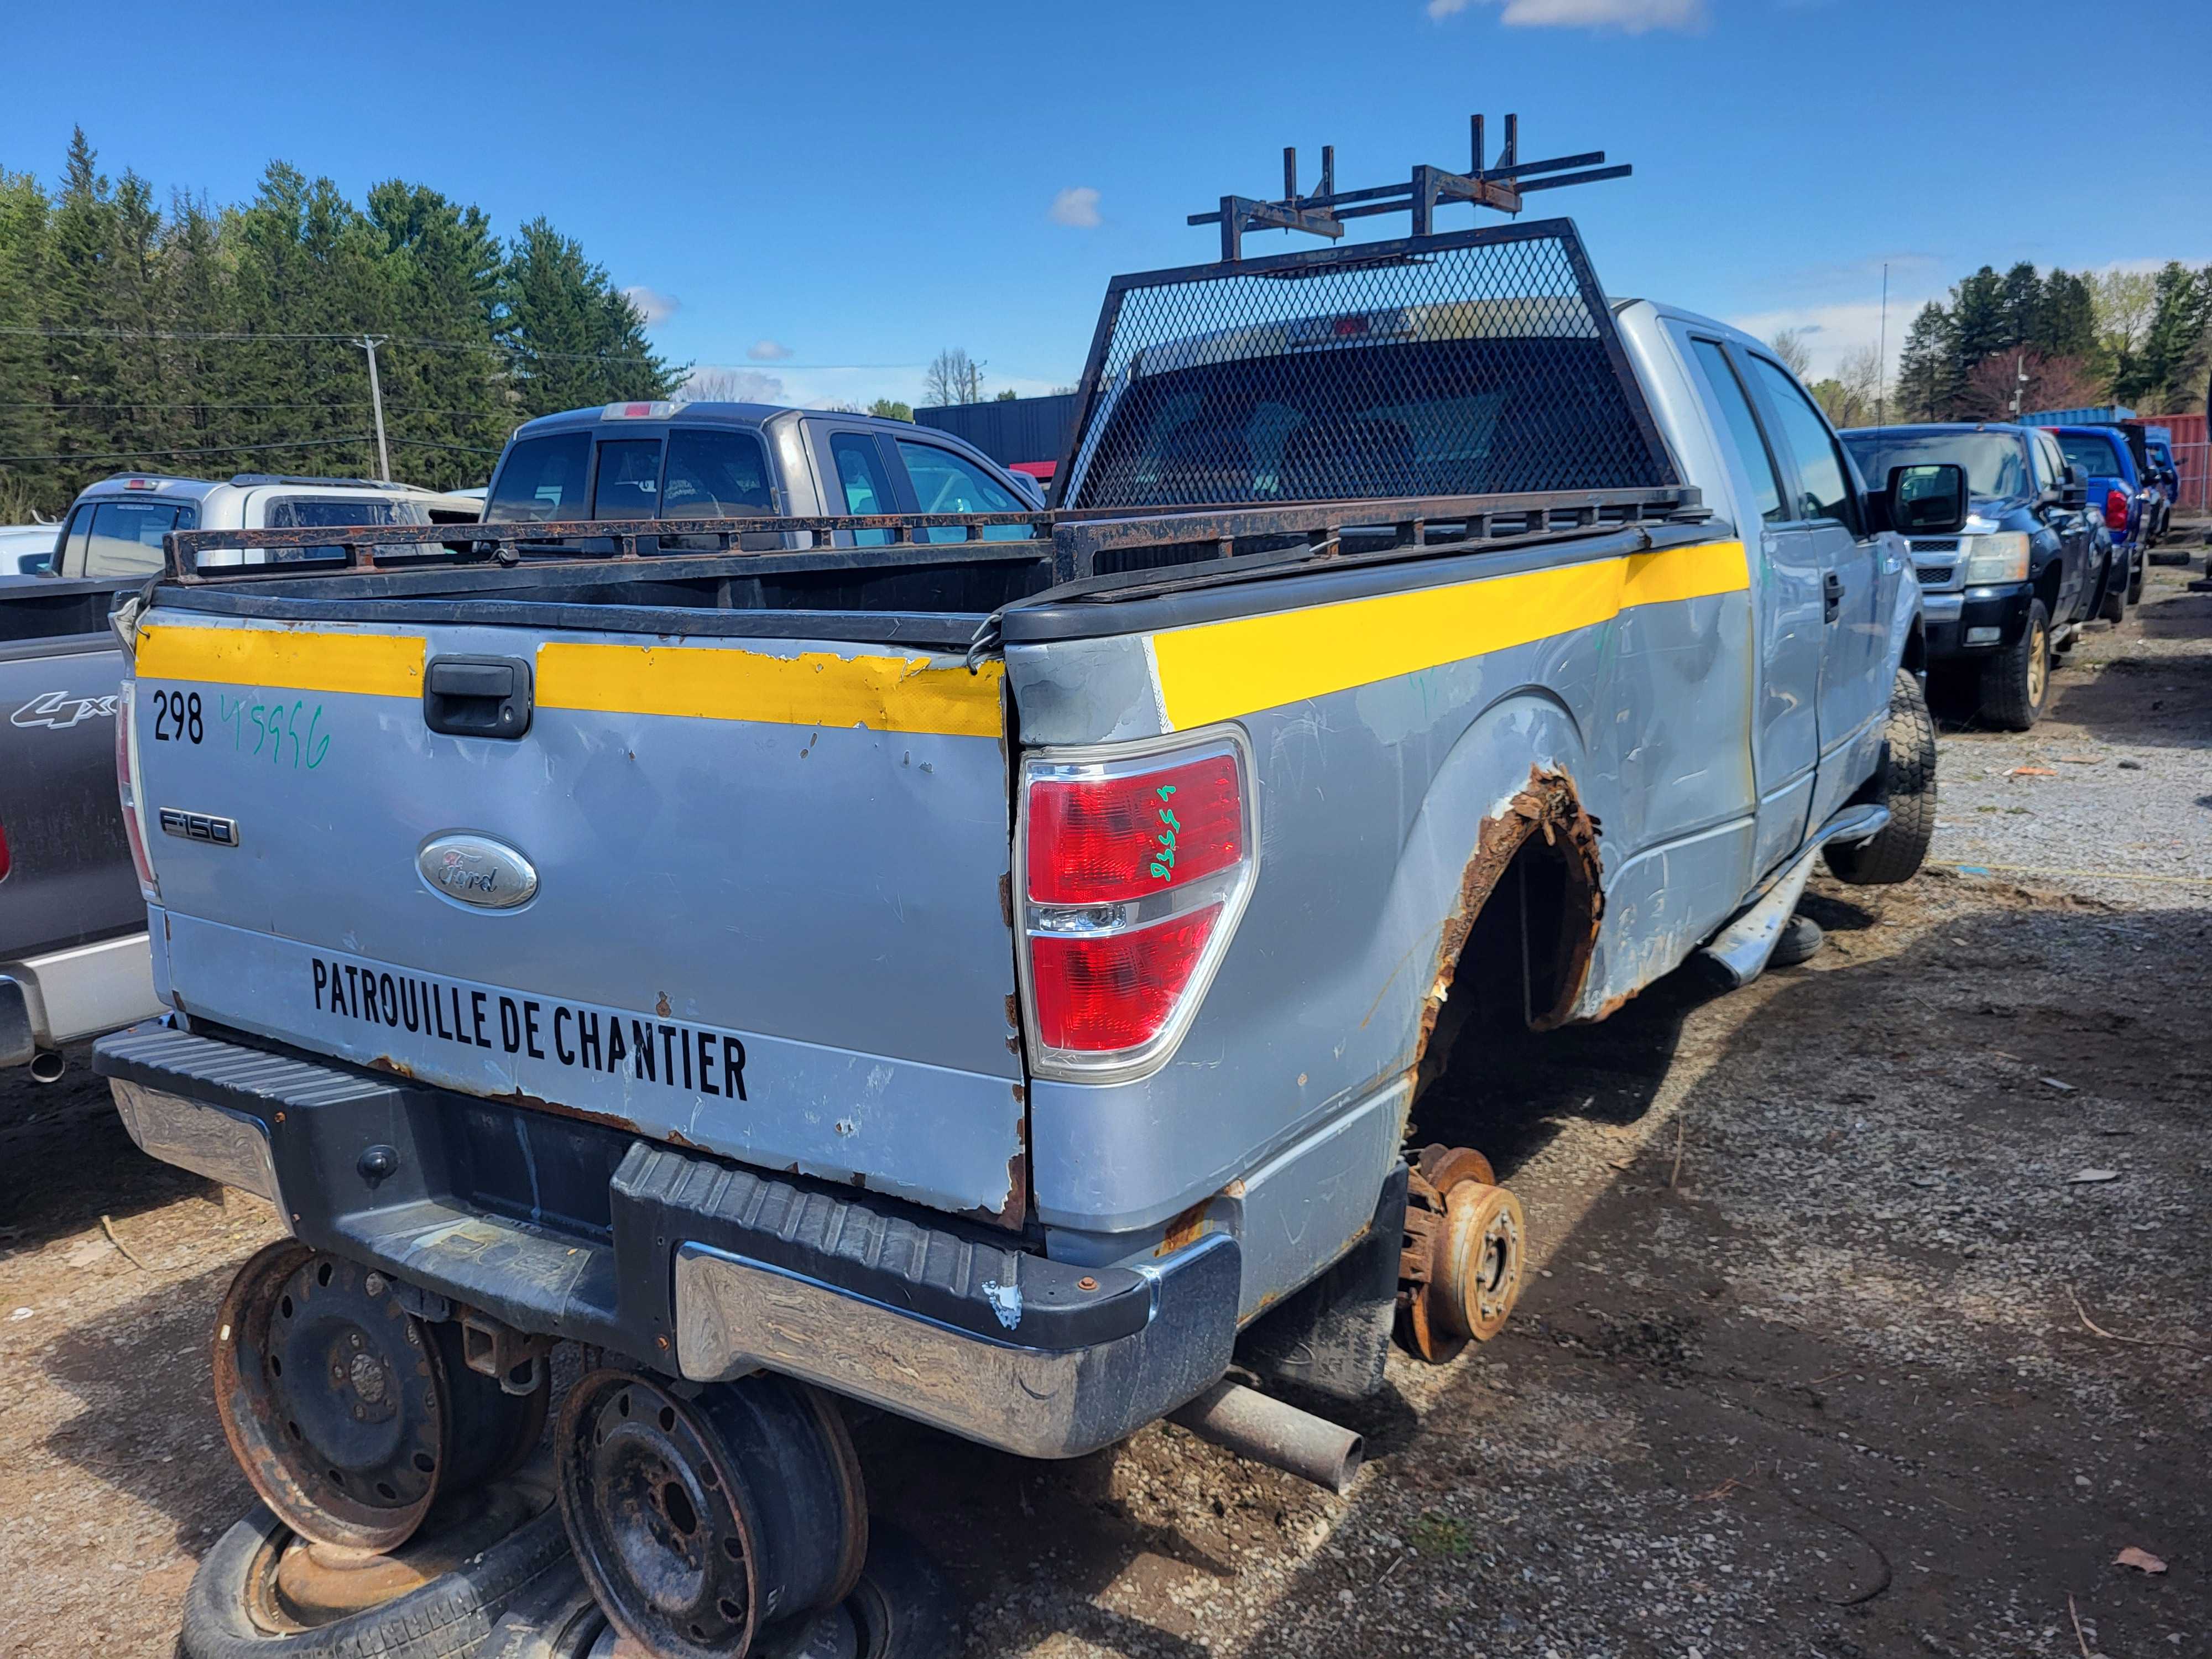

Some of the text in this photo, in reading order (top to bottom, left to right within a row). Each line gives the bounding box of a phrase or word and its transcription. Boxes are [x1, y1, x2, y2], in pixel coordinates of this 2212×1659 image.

[153, 690, 204, 744] 298
[437, 848, 499, 894] Ford
[312, 957, 748, 1102] PATROUILLE DE CHANTIER
